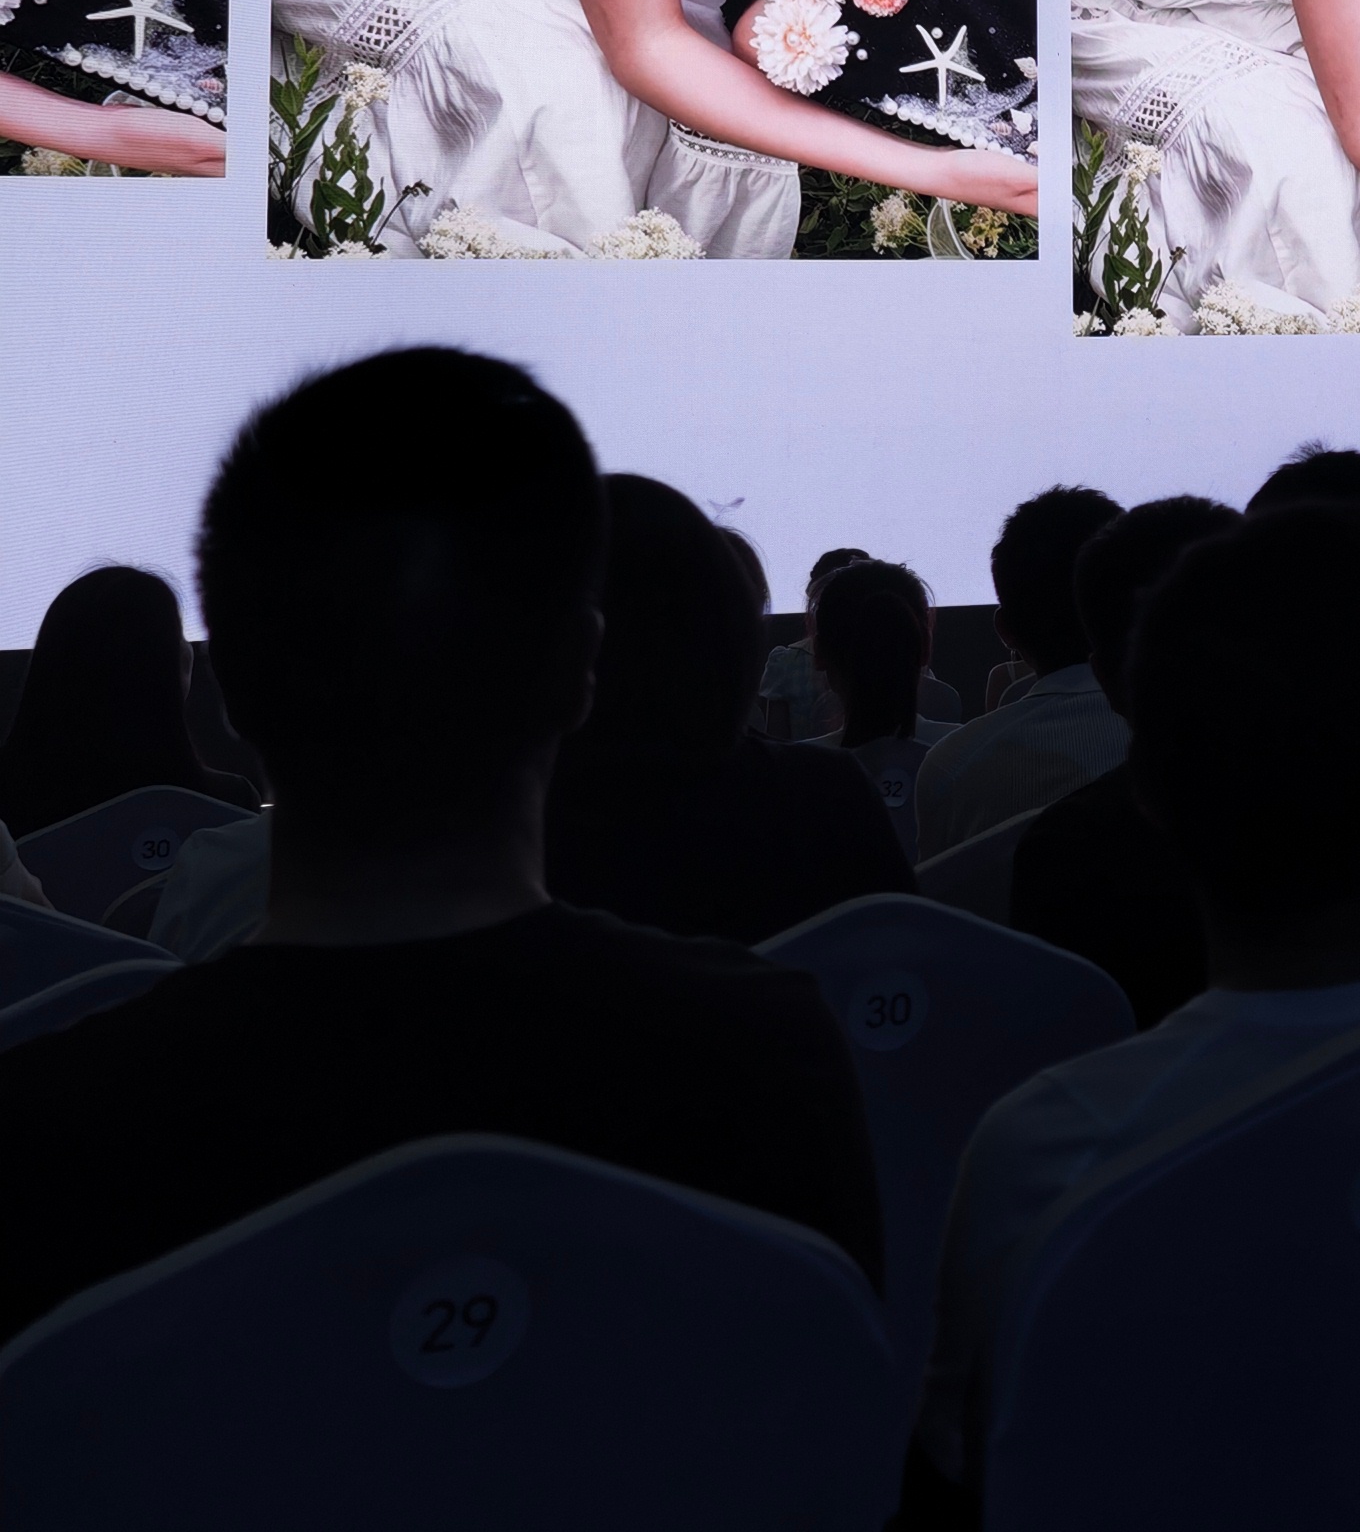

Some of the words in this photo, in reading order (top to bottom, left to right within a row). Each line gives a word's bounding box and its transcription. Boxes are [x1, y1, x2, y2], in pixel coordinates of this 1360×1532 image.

[881, 779, 904, 798] 32
[141, 838, 171, 860] 30
[865, 991, 913, 1030] 30
[419, 1293, 500, 1355] 29
